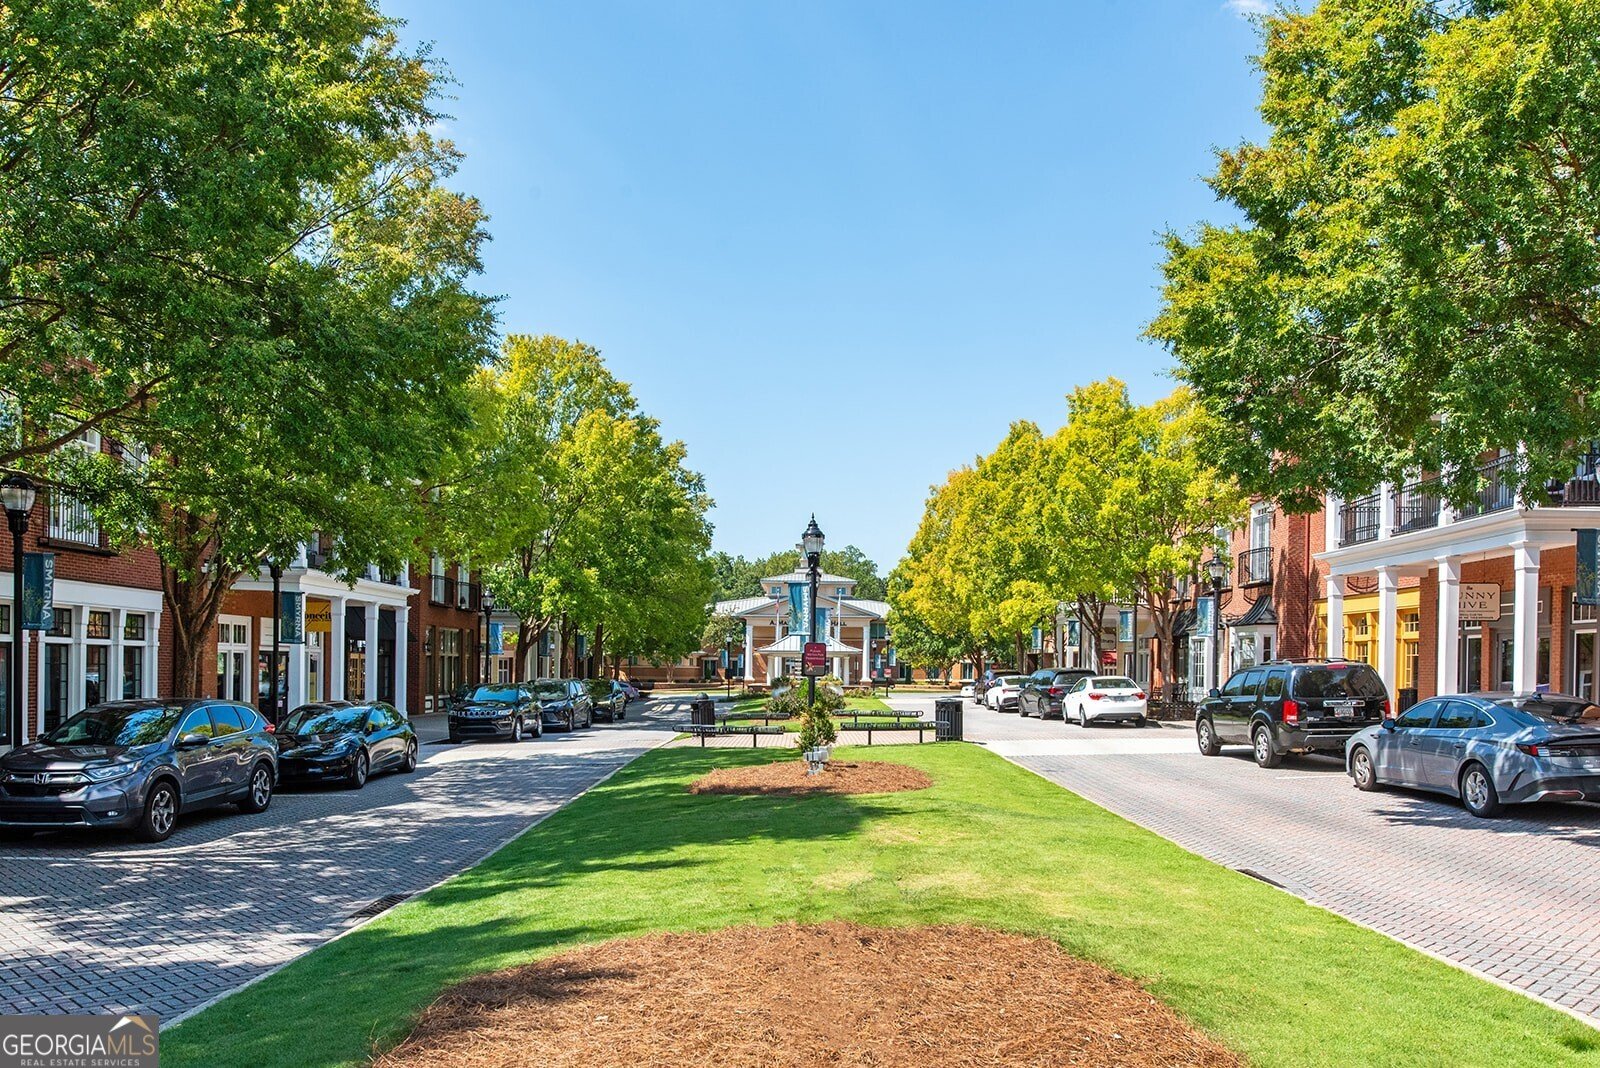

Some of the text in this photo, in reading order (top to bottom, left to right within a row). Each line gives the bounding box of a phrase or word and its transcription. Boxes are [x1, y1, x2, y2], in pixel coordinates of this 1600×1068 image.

[43, 559, 54, 620] SMYRNA
[802, 585, 810, 628] SMYRNA
[294, 595, 302, 638] SMYRNA
[305, 611, 332, 621] onceit
